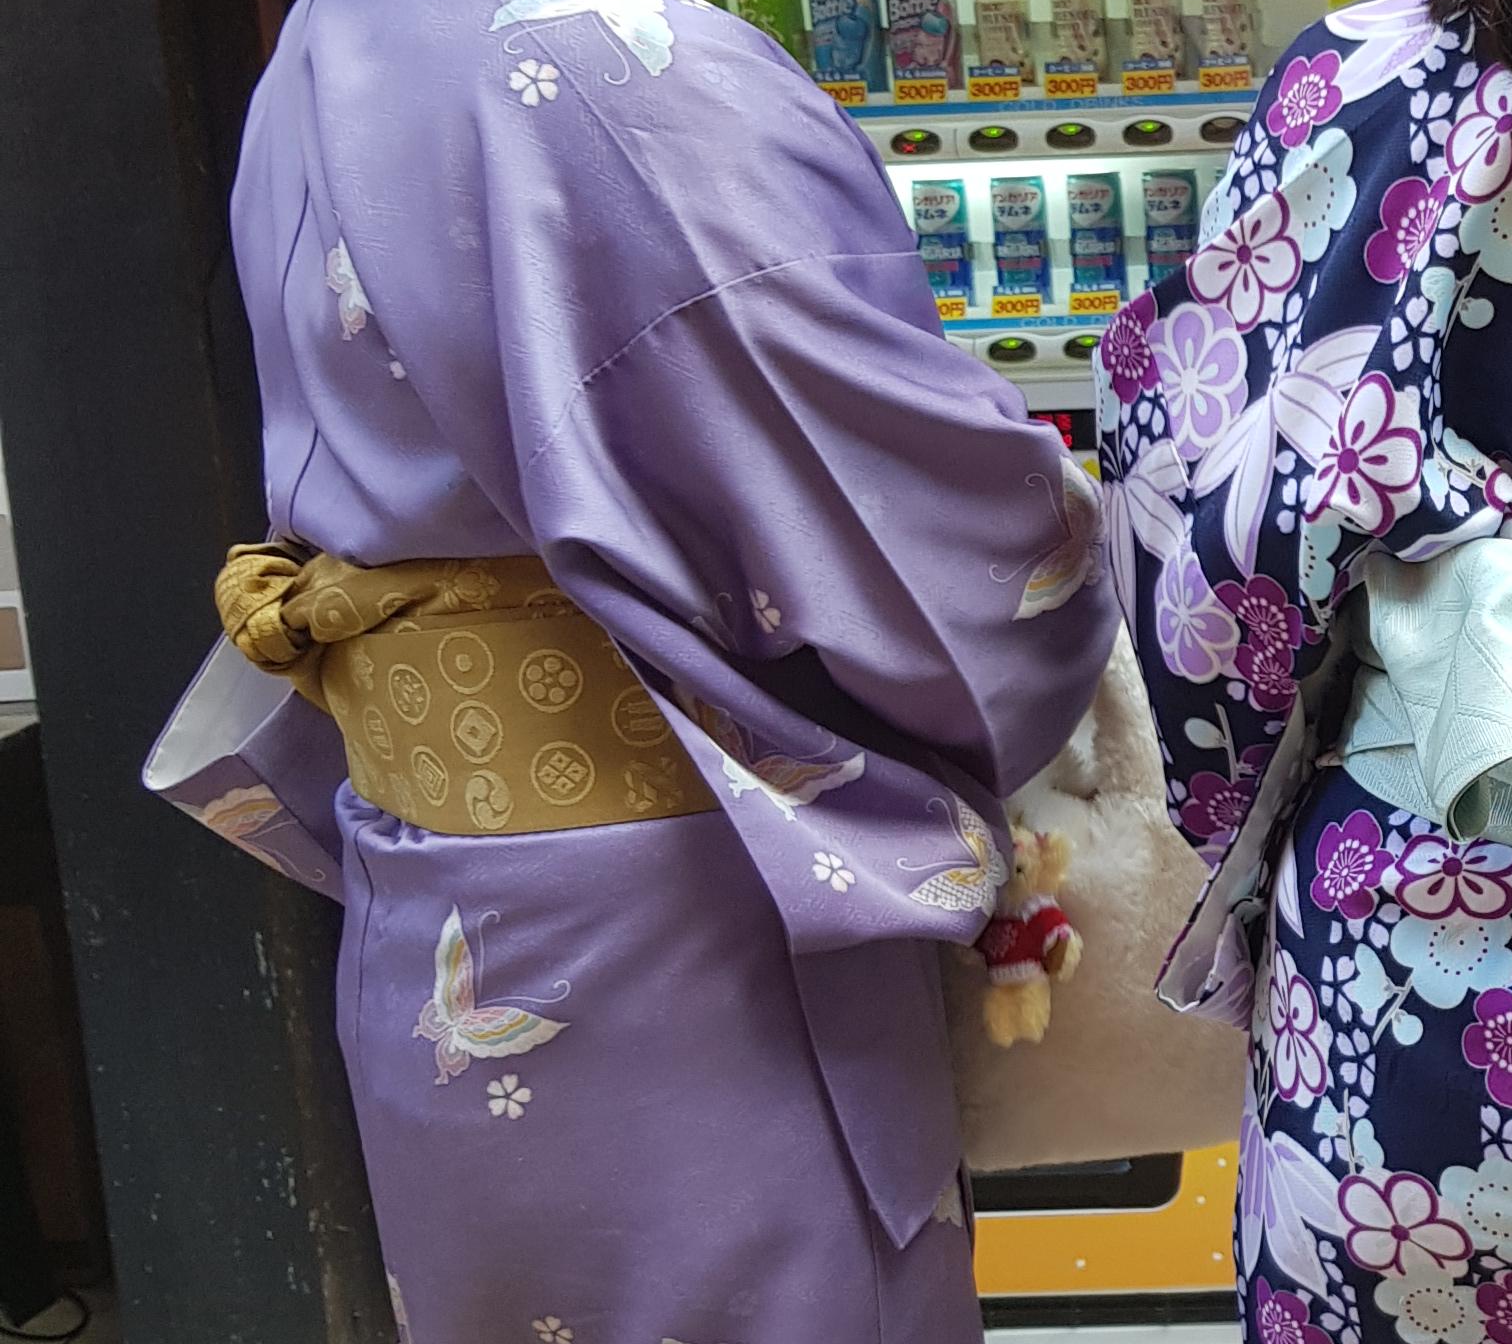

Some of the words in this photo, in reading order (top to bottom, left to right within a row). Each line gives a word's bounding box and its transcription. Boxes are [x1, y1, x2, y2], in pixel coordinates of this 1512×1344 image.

[1048, 78, 1096, 95] 300円
[1126, 74, 1174, 91] 300円
[1203, 70, 1250, 87] 300円
[823, 86, 865, 103] 00円
[898, 84, 945, 100] 500円
[970, 81, 1019, 98] 300円
[998, 205, 1032, 218] ラムネ
[995, 298, 1039, 314] 300円
[1072, 295, 1118, 311] 300円
